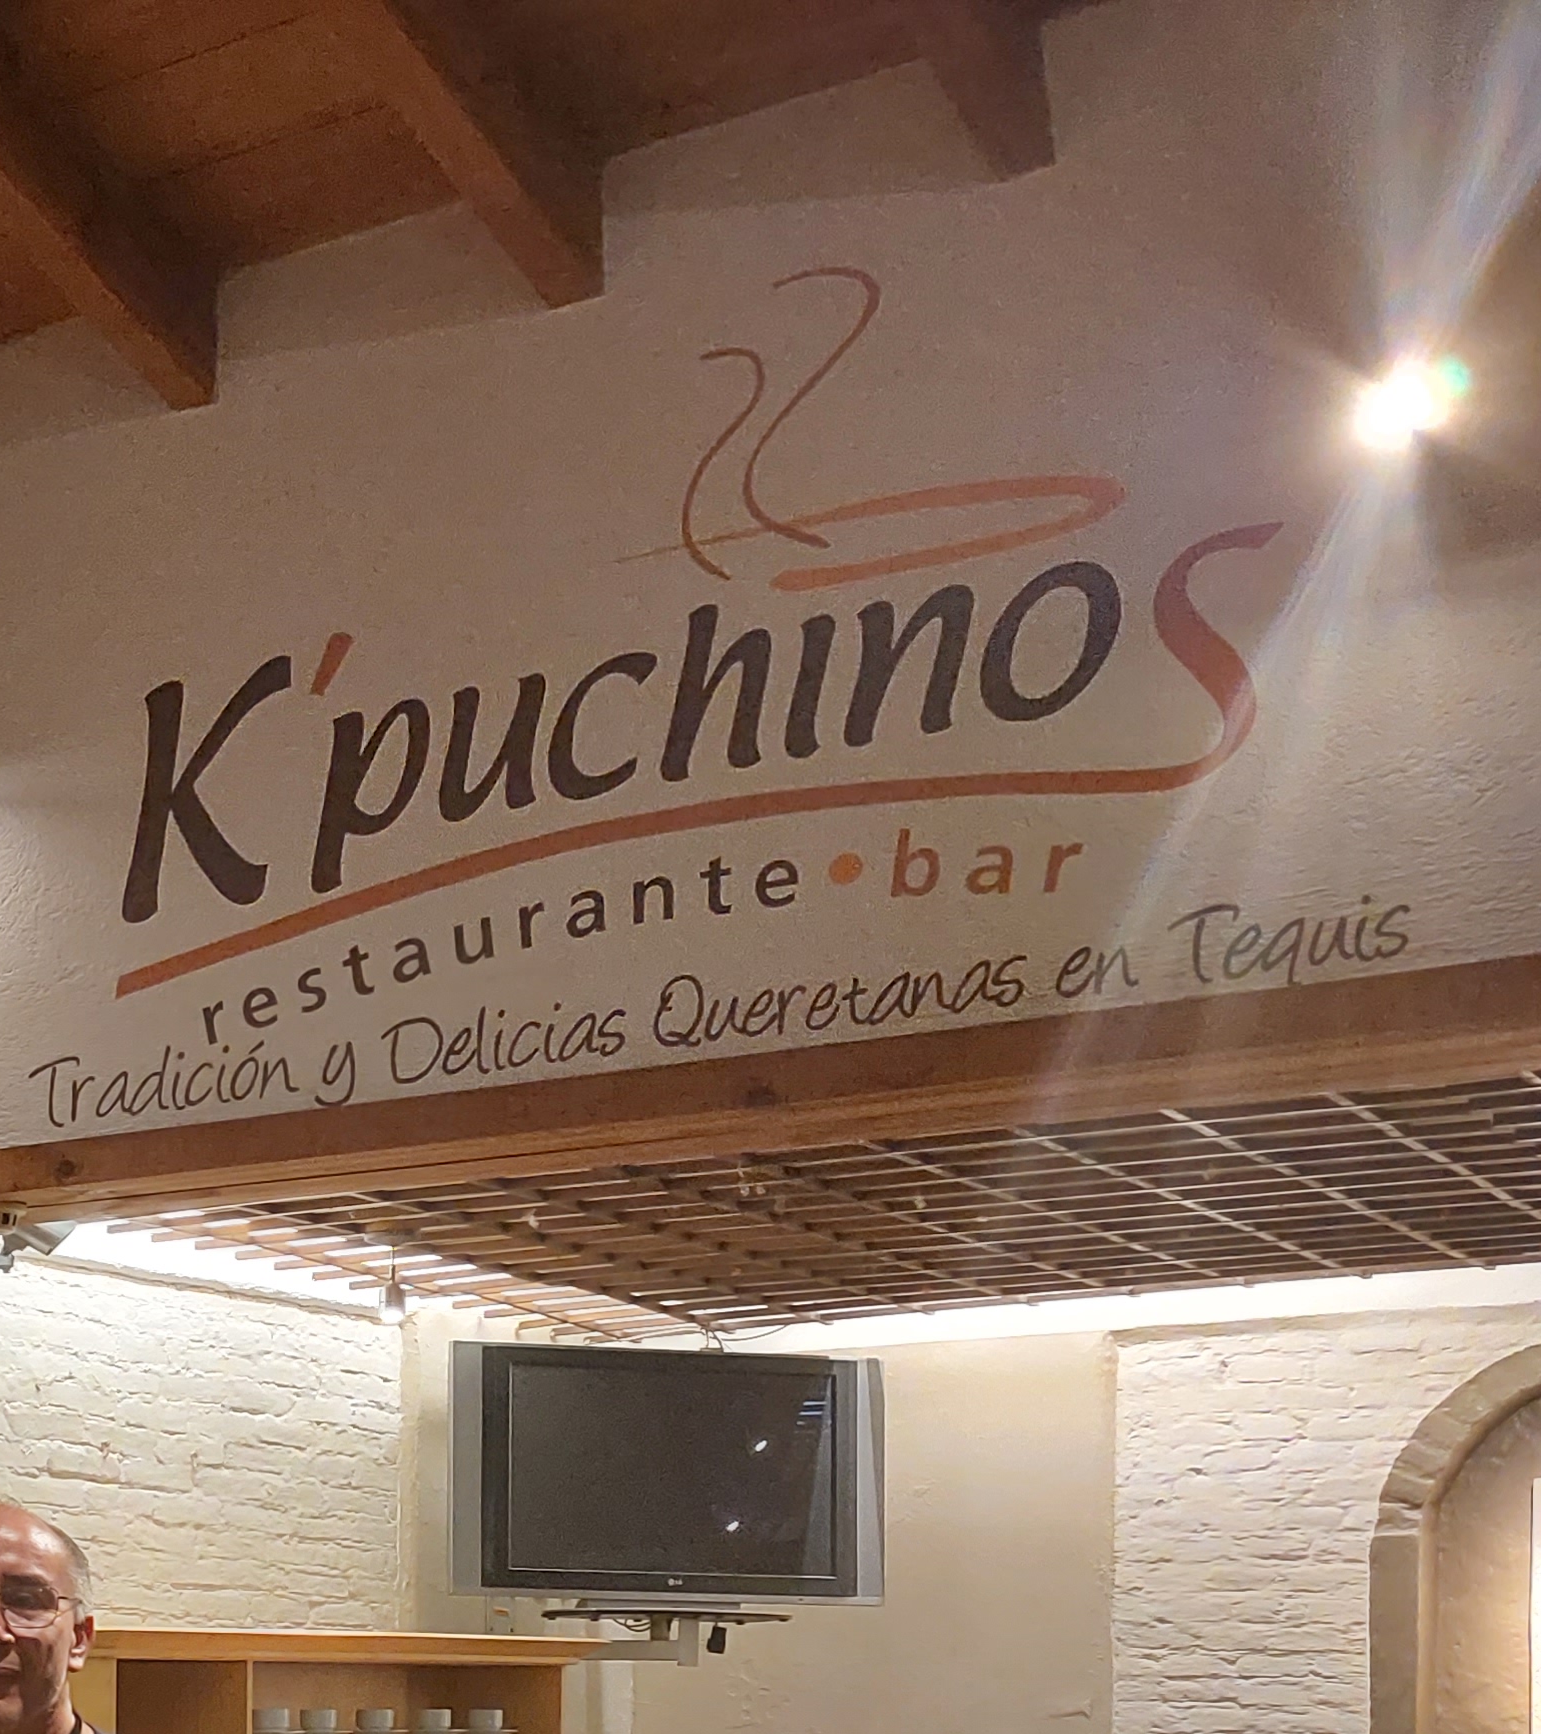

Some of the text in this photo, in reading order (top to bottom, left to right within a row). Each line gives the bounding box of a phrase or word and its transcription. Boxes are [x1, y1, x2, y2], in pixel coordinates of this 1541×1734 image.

[28, 896, 1413, 1128] Tradición y Delicias Queretanas en Tequis
[201, 827, 1085, 1046] restaurante bar
